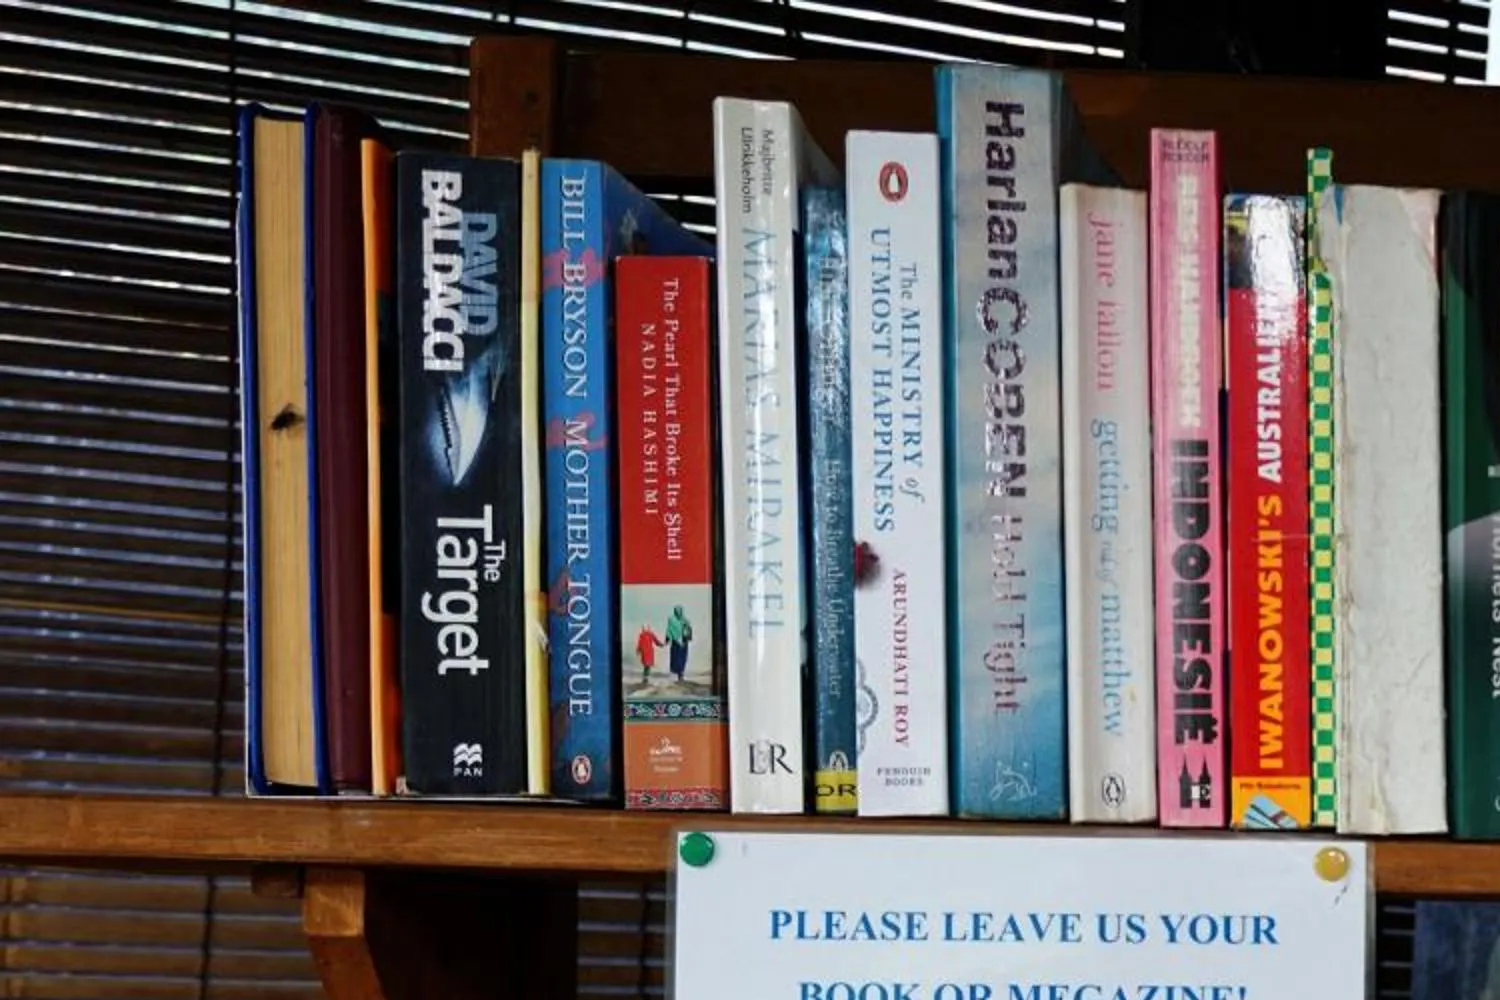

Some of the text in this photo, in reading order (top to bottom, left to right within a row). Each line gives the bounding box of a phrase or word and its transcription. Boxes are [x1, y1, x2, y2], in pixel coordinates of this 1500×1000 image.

[421, 168, 465, 372] BALDACCI
[462, 212, 498, 337] DAVID
[984, 100, 1027, 281] Harlan
[1088, 211, 1122, 288] jane
[561, 174, 588, 398] BILL BRYSON
[900, 263, 923, 471] The MINISTRY
[640, 322, 659, 514] NADIA HASHIMI
[663, 277, 682, 561] The Pearl That Broke Its Shell
[870, 227, 896, 532] UTMOST HAPPINESS
[421, 504, 492, 676] Target
[484, 540, 506, 583] The
[565, 418, 593, 717] MOTHER TONGUE
[745, 427, 785, 641] MIRAKEL
[893, 570, 910, 747] ARUNDHATI ROY
[1100, 594, 1132, 737] matthew
[1258, 494, 1285, 770] IWANOWSKI'S
[453, 767, 483, 777] PAN
[769, 909, 1279, 946] PLEASE LEAVE US YOUR
